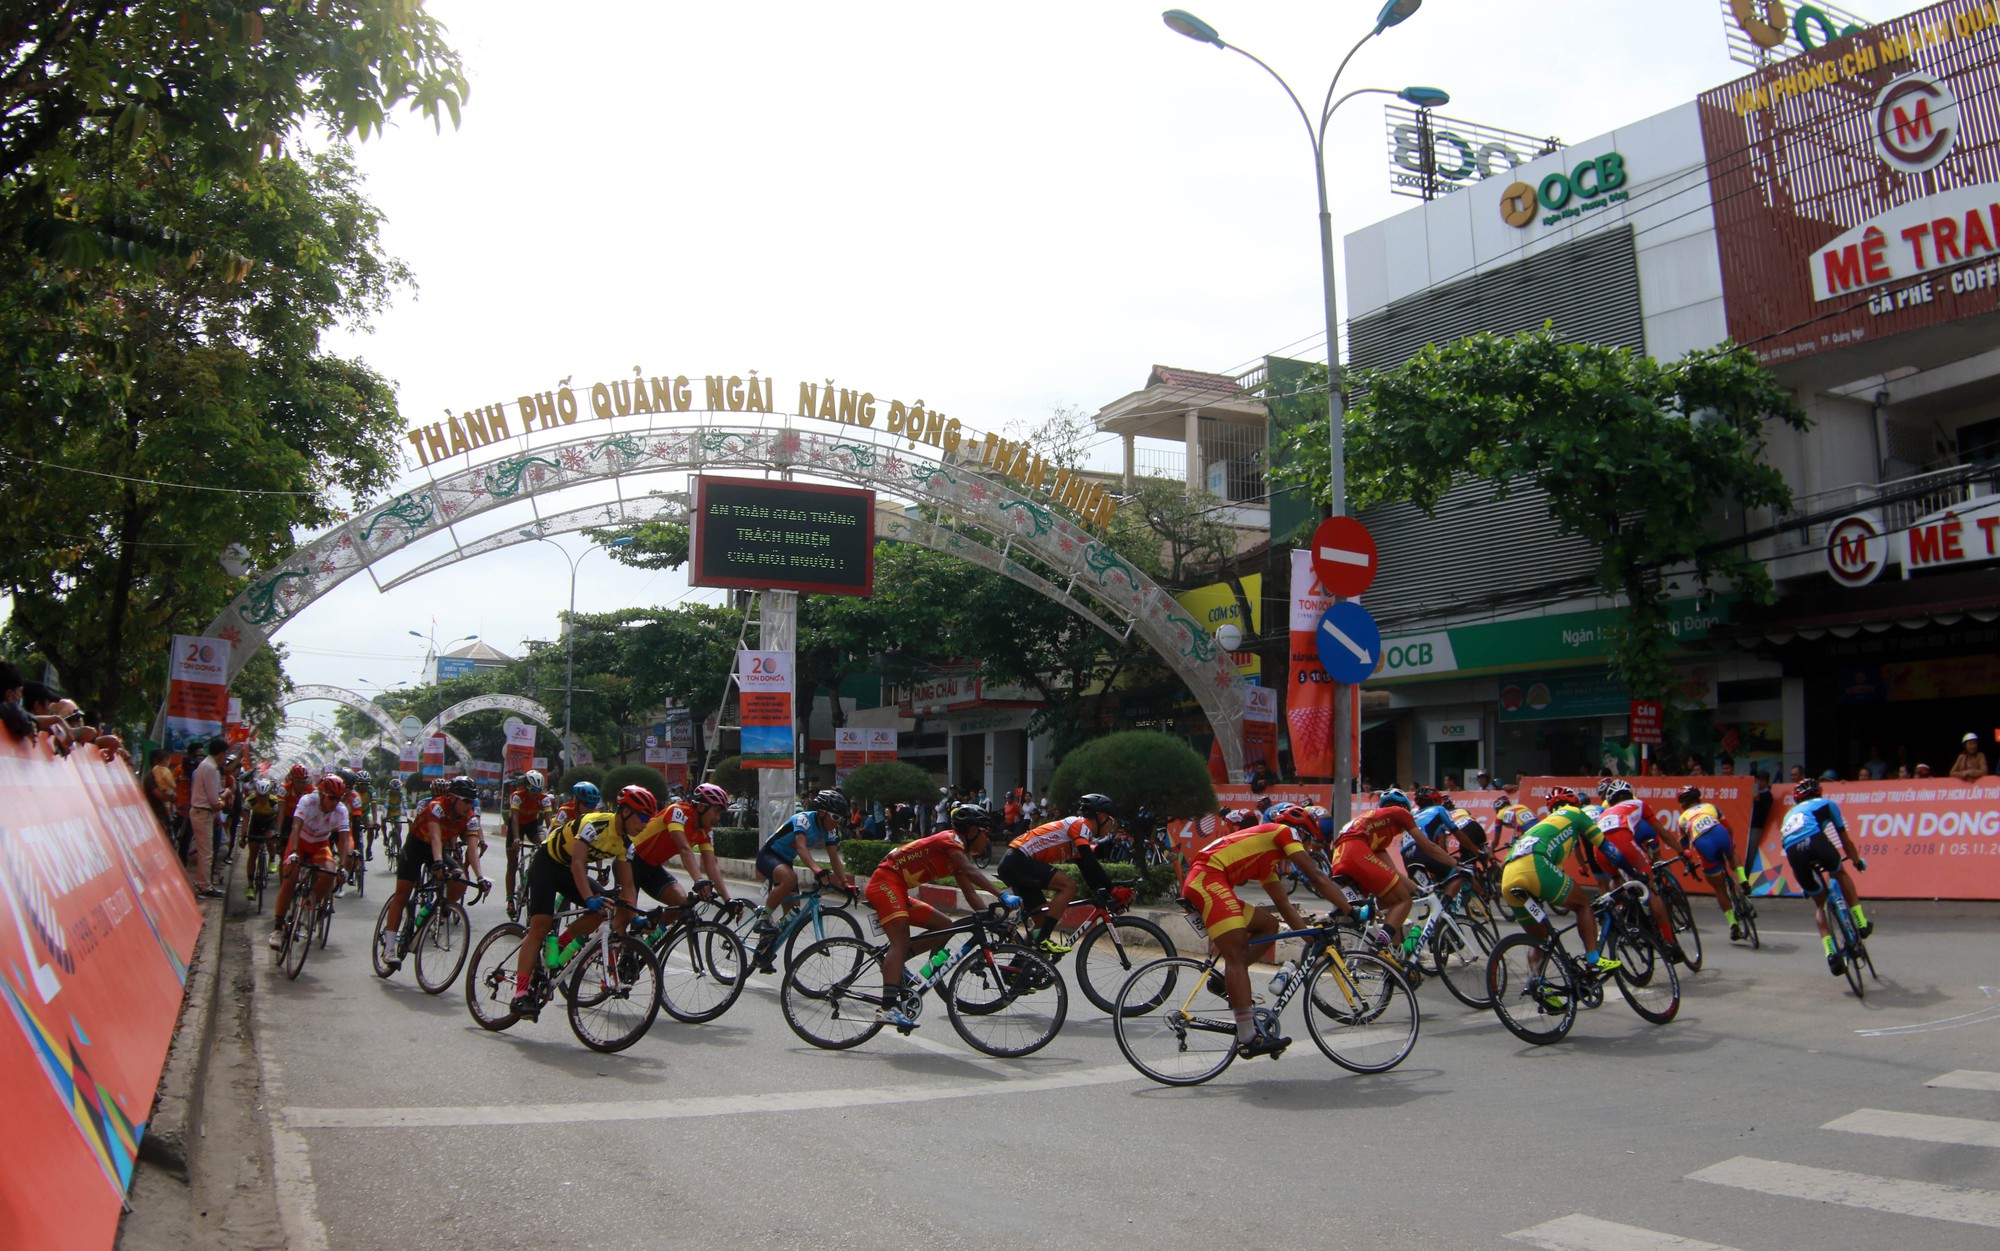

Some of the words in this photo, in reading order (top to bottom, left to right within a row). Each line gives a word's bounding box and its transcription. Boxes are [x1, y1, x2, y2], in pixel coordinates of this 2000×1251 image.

[1842, 45, 1878, 76] CHI
[1537, 152, 1627, 210] OCB
[1823, 225, 1892, 294] MÊ
[1868, 286, 1893, 315] CÀ
[1897, 277, 1934, 310] PHÊ
[1951, 263, 2000, 295] COFF
[407, 408, 510, 467] THÀNH
[517, 375, 578, 433] PHỐ
[592, 365, 692, 419] QUẢNG
[799, 378, 876, 428] NĂNG
[887, 399, 961, 450] ĐỘNG
[981, 432, 1049, 490] THÂN
[710, 504, 729, 515] AN
[732, 504, 769, 518] TOÀN
[772, 509, 807, 521] GIAO
[809, 511, 856, 526] THÔNG
[736, 527, 781, 543] TRÁCH
[785, 531, 831, 548] NHIỆM
[1909, 512, 1965, 564] MÊ
[1386, 642, 1434, 669] OCB
[1562, 629, 1594, 648] Ngân
[1637, 704, 1656, 717] CẤM
[1857, 813, 1915, 838] TON
[1917, 811, 2000, 837] DONG
[1905, 843, 1935, 855] 2018
[1529, 903, 1541, 915] 56
[1273, 955, 1316, 1013] S-WORKS
